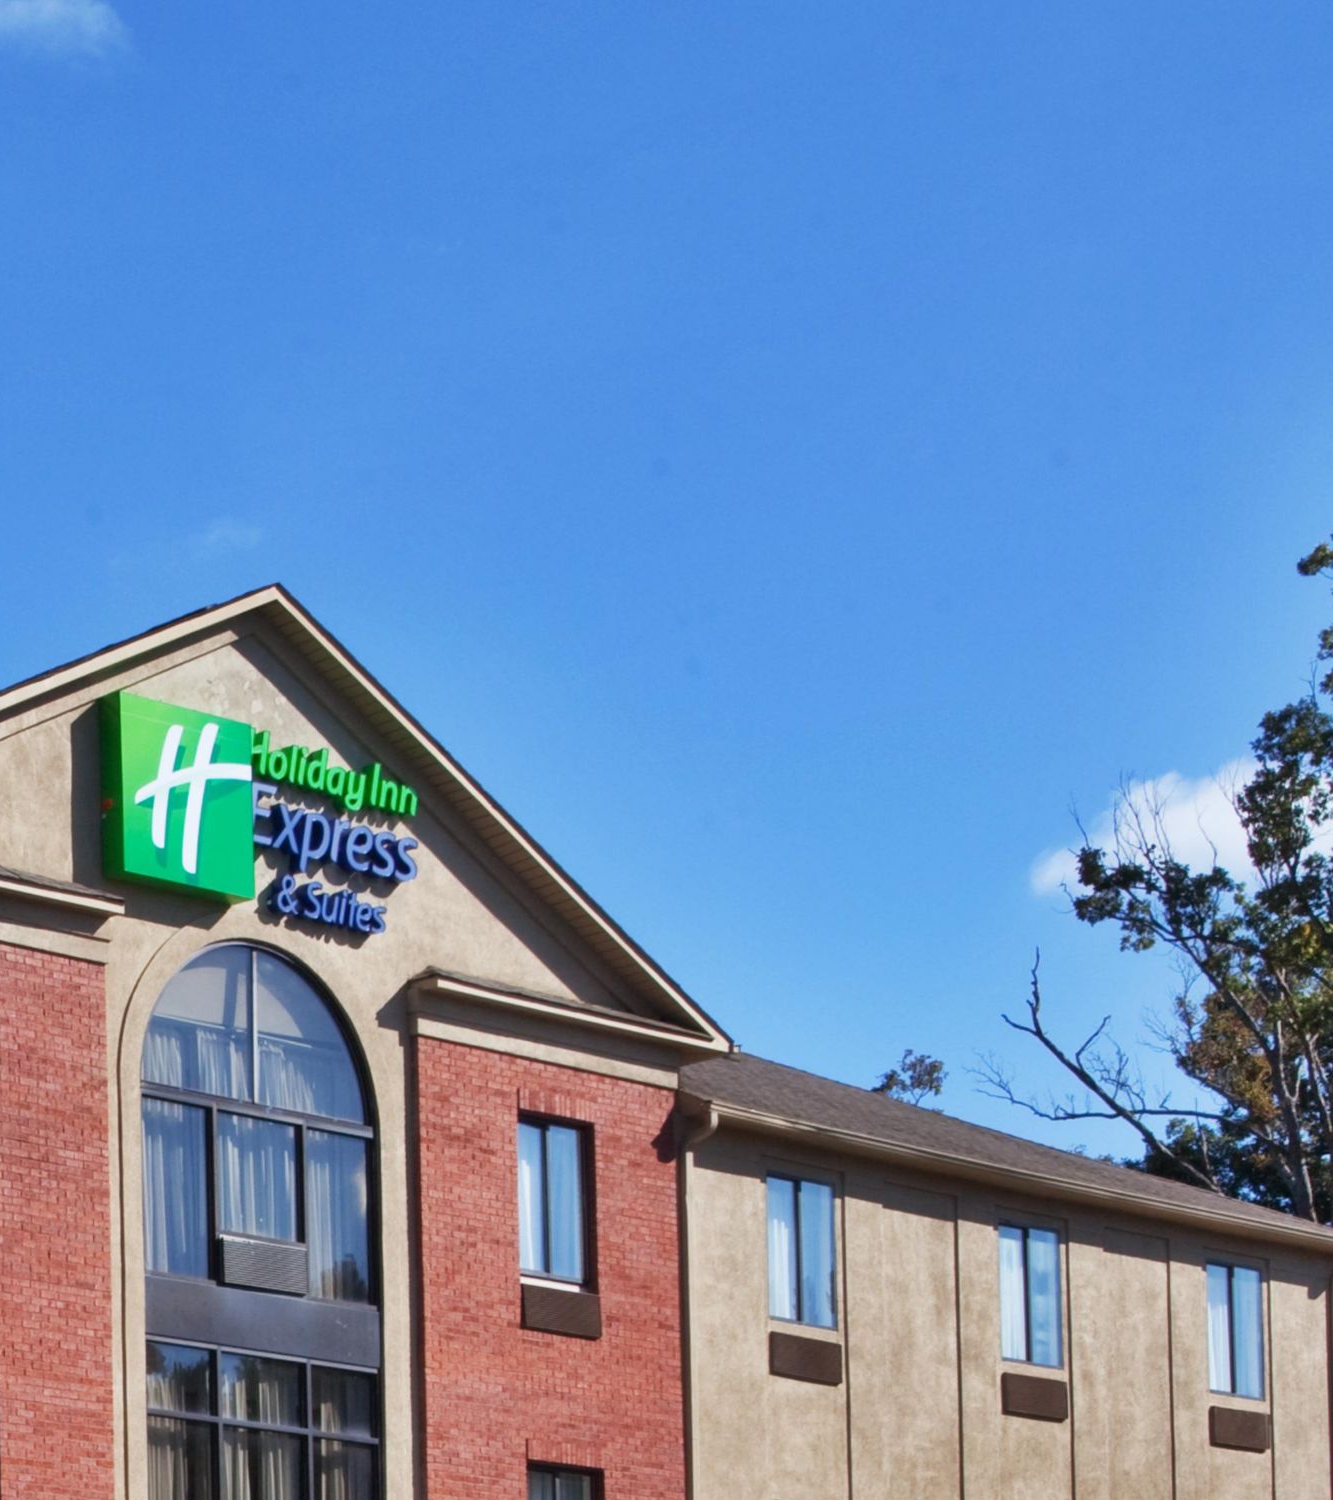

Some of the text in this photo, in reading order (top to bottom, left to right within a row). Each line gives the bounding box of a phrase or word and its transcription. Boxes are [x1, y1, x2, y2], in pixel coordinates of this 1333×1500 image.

[134, 722, 252, 874] H
[250, 726, 419, 817] Holiday Inn
[252, 781, 419, 882] Express
[277, 873, 387, 934] & Suites
